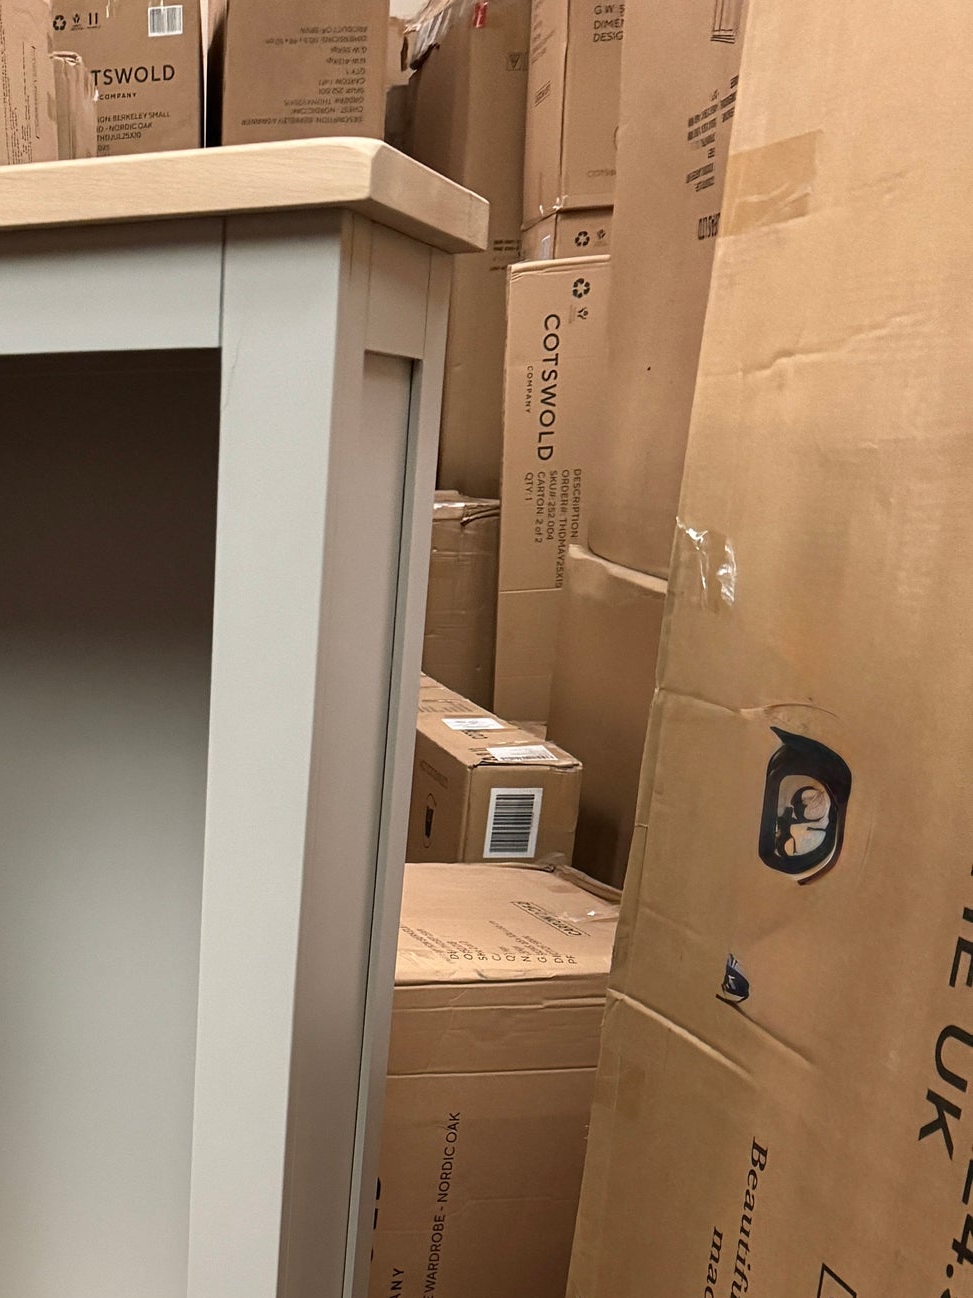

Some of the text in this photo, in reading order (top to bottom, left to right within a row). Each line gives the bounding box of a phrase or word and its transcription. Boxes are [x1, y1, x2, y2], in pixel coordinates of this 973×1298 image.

[525, 365, 533, 414] COMPANY
[537, 313, 561, 461] COTSWOLD
[445, 1112, 461, 1143] OAK
[437, 1146, 456, 1203] NORDIC
[423, 1214, 446, 1295] WARDROBE
